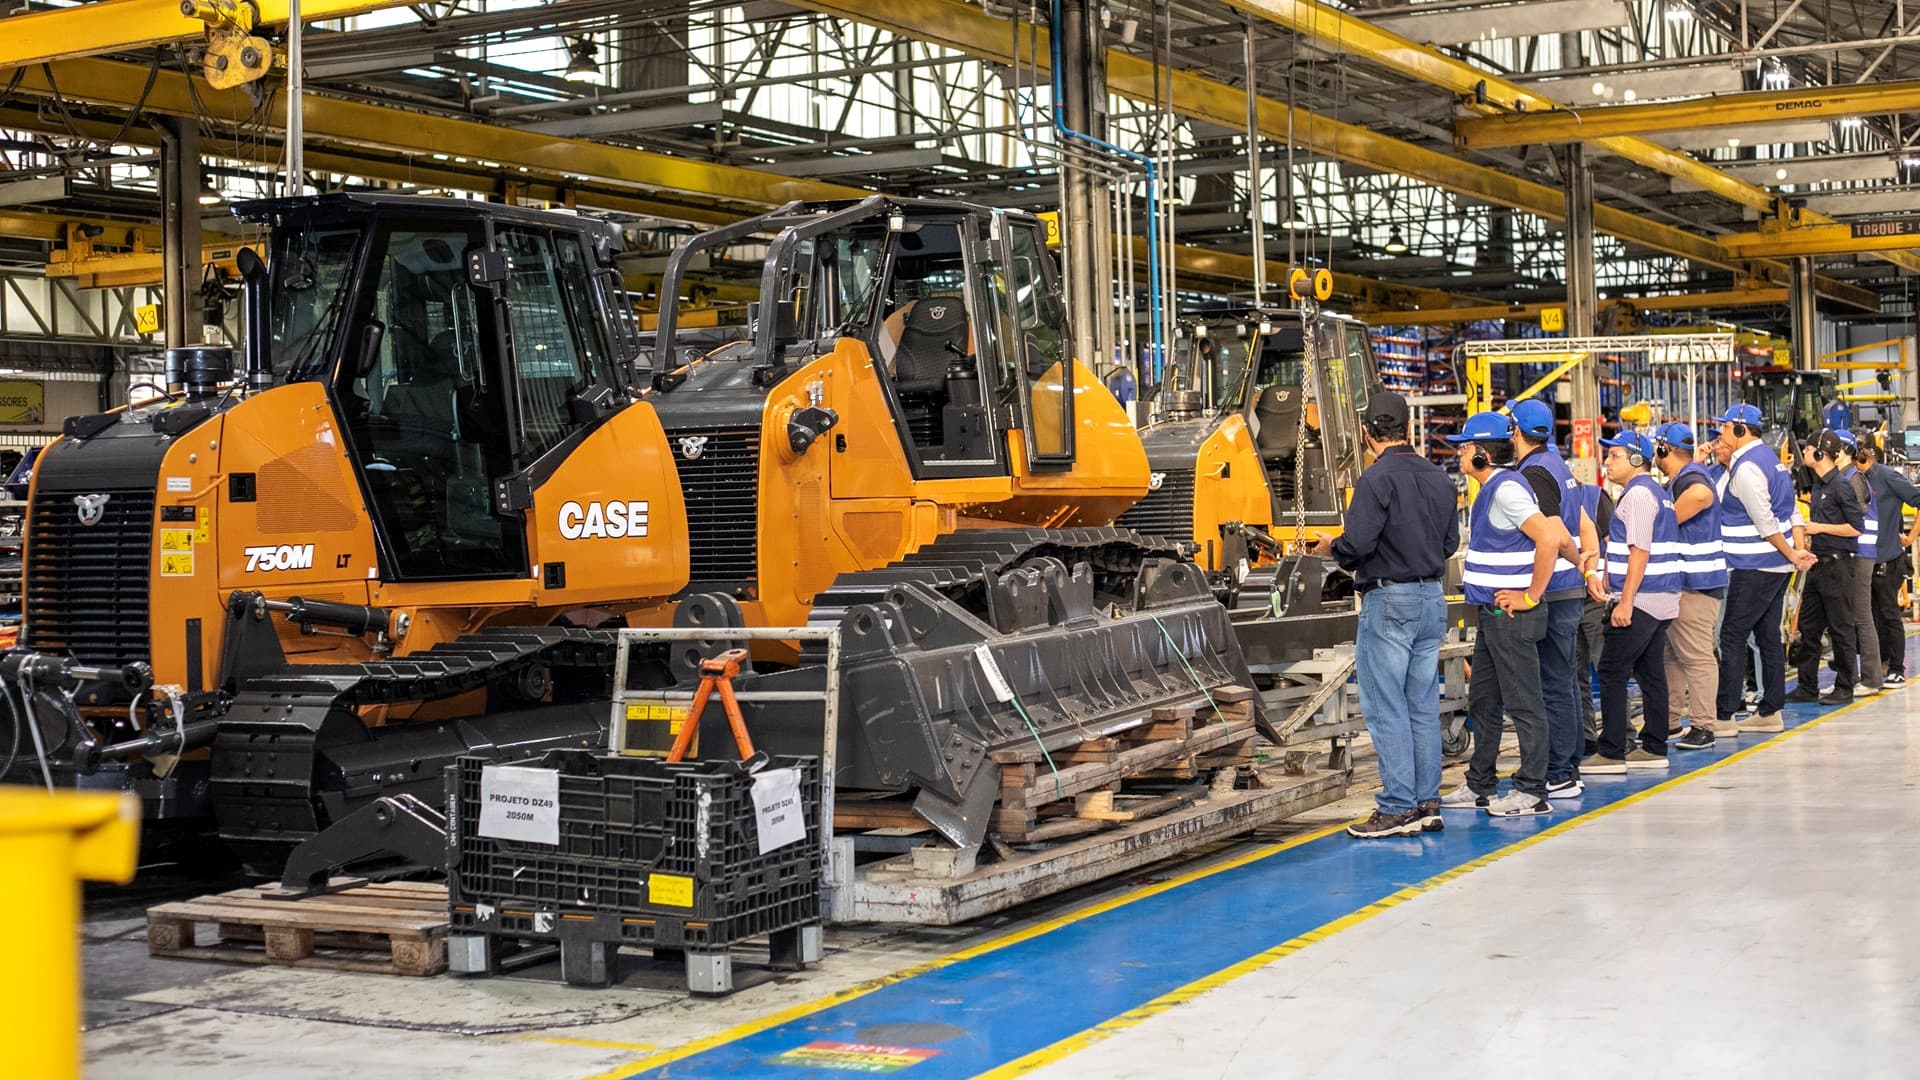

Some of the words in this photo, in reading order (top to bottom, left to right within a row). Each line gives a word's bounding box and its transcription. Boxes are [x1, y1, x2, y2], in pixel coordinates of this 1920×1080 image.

[1775, 100, 1822, 111] DEMAG
[1856, 222, 1904, 236] TORQUE
[138, 310, 156, 327] X3
[1543, 312, 1559, 325] V4
[558, 500, 648, 540] CASE
[244, 544, 314, 573] 750M
[336, 554, 352, 568] LT
[489, 794, 529, 806] PROJETO
[532, 798, 553, 808] DZ49
[506, 811, 534, 821] 2050M
